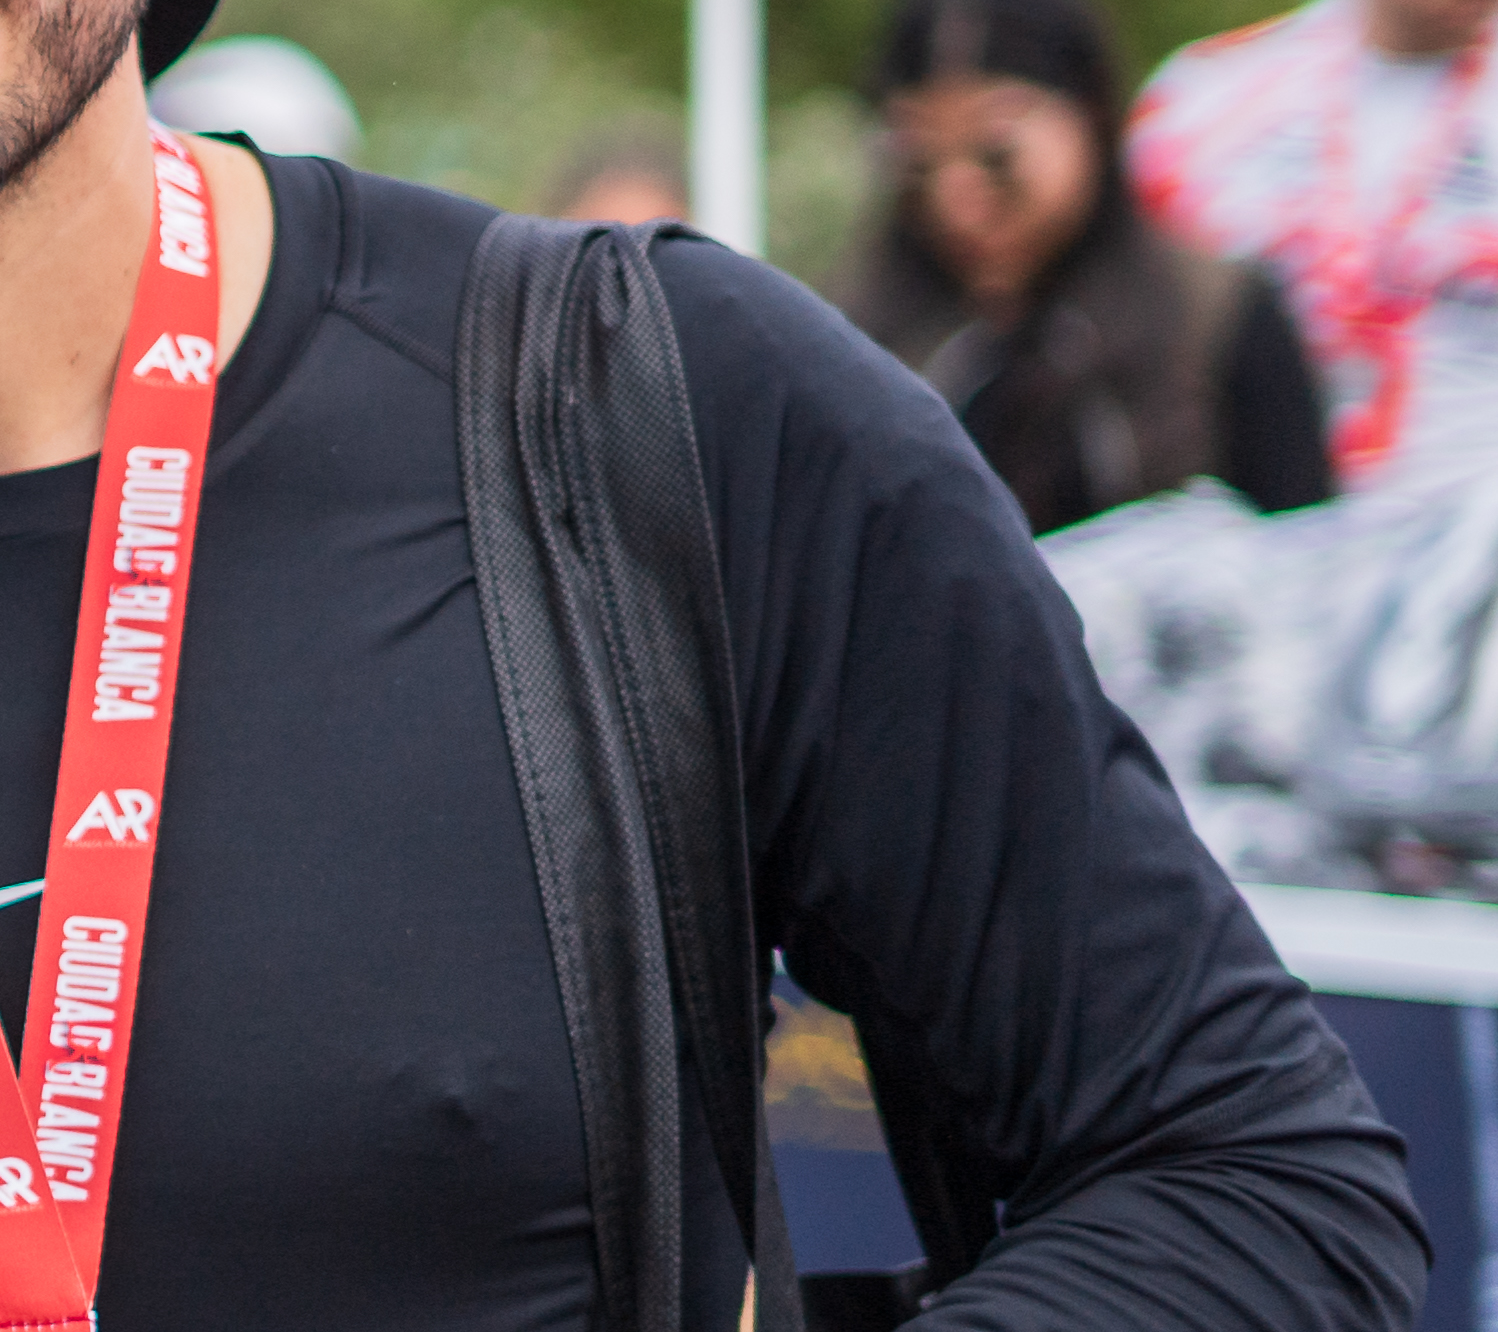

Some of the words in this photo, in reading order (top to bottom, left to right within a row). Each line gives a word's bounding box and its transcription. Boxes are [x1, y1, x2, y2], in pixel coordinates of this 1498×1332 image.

[133, 332, 214, 384] AR
[91, 573, 172, 722] BLANCA
[66, 788, 154, 842] AR
